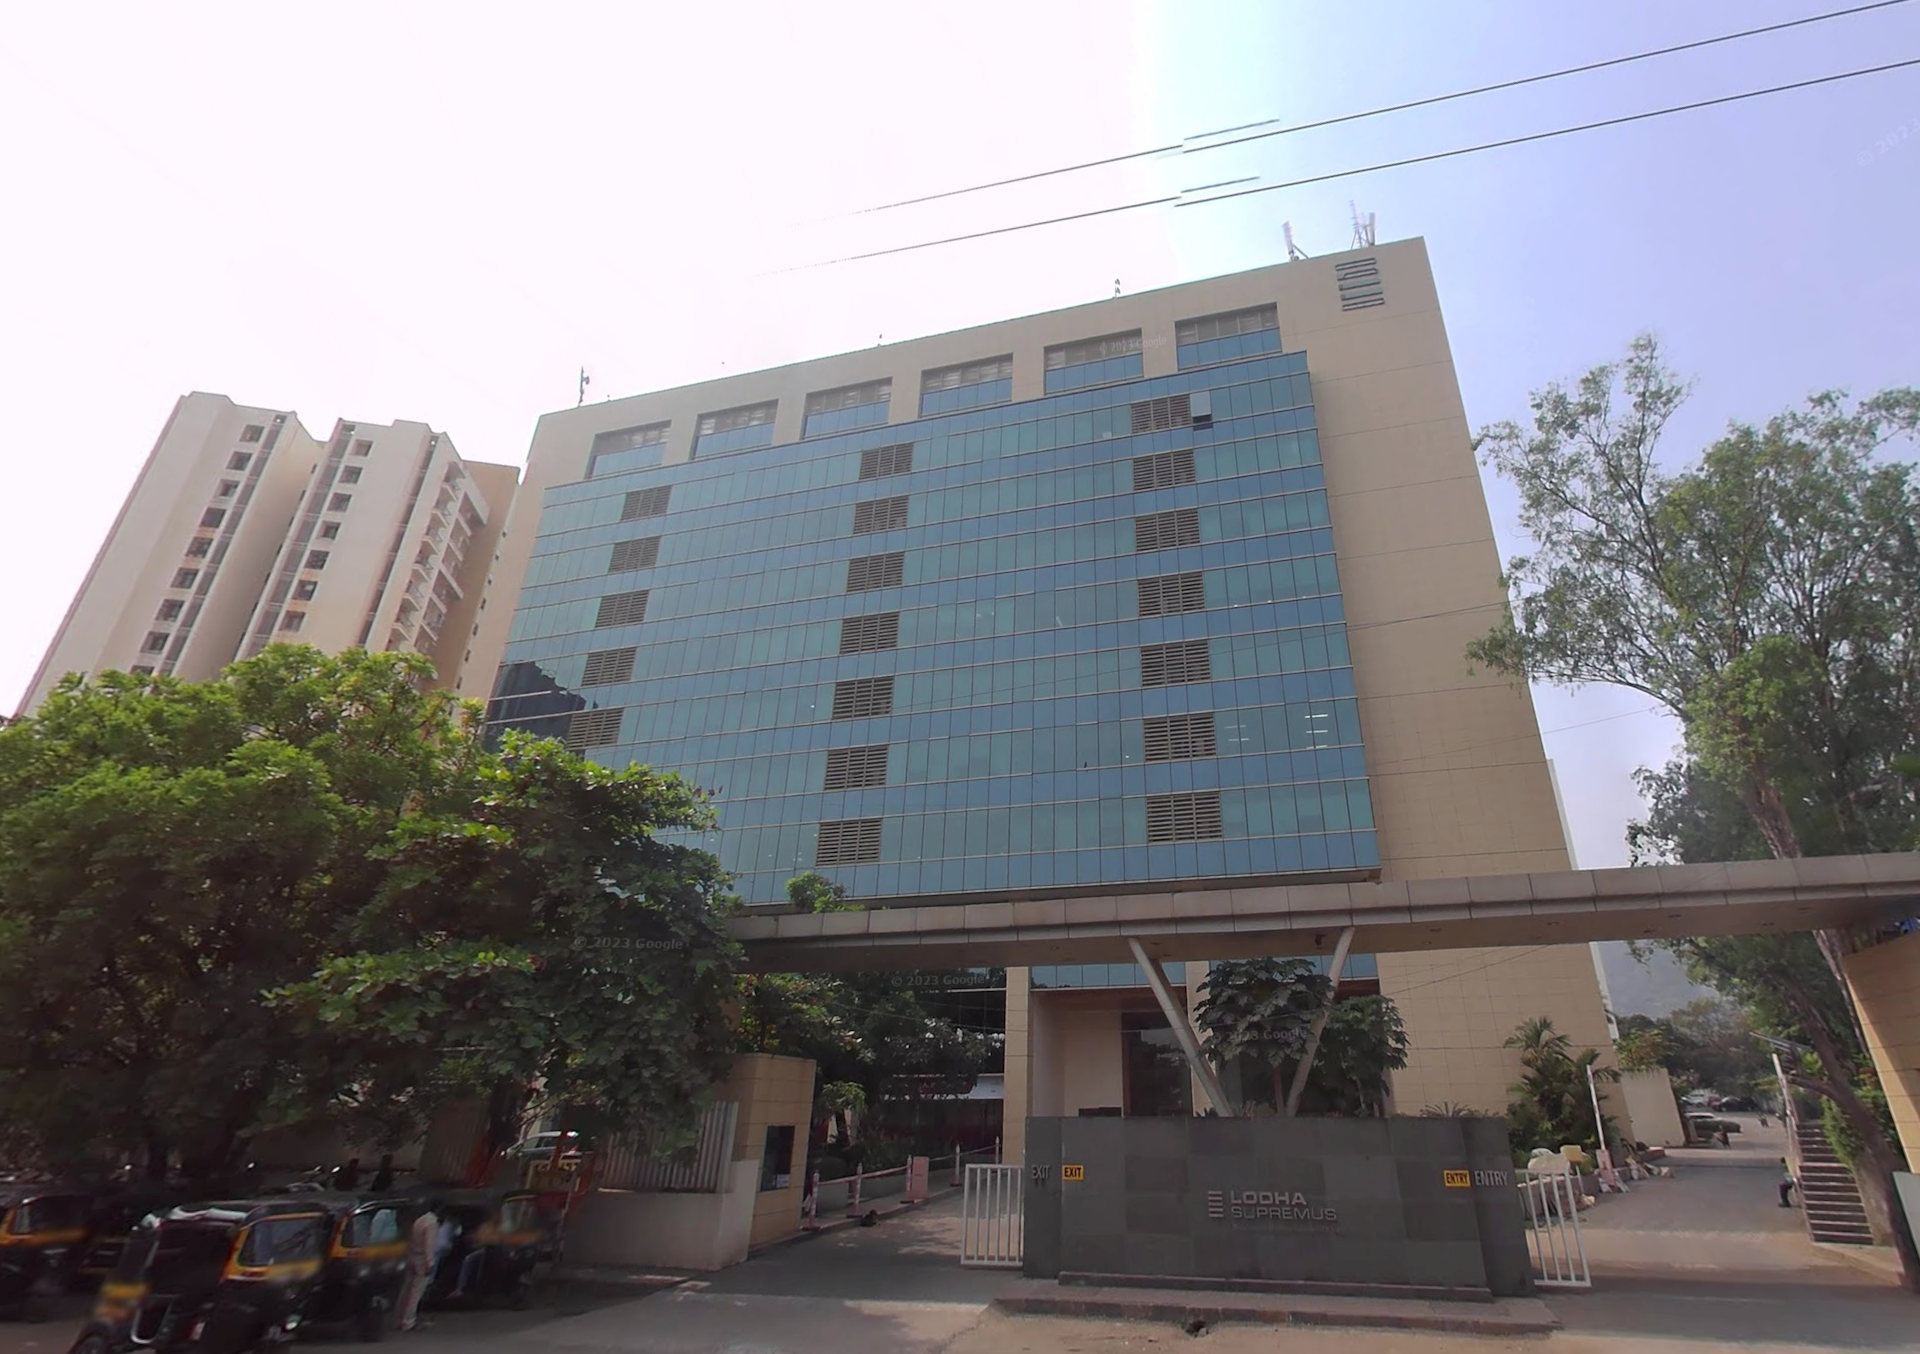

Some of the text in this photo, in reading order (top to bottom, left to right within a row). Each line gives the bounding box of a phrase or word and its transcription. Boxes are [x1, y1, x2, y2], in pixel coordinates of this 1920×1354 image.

[1032, 1164, 1050, 1179] EXIT
[1064, 1167, 1082, 1178] EXIT
[1445, 1172, 1469, 1185] ENTRY
[1474, 1170, 1508, 1187] ENTRY
[1230, 1190, 1307, 1206] LODHA
[1231, 1206, 1337, 1221] SUPREMUS
